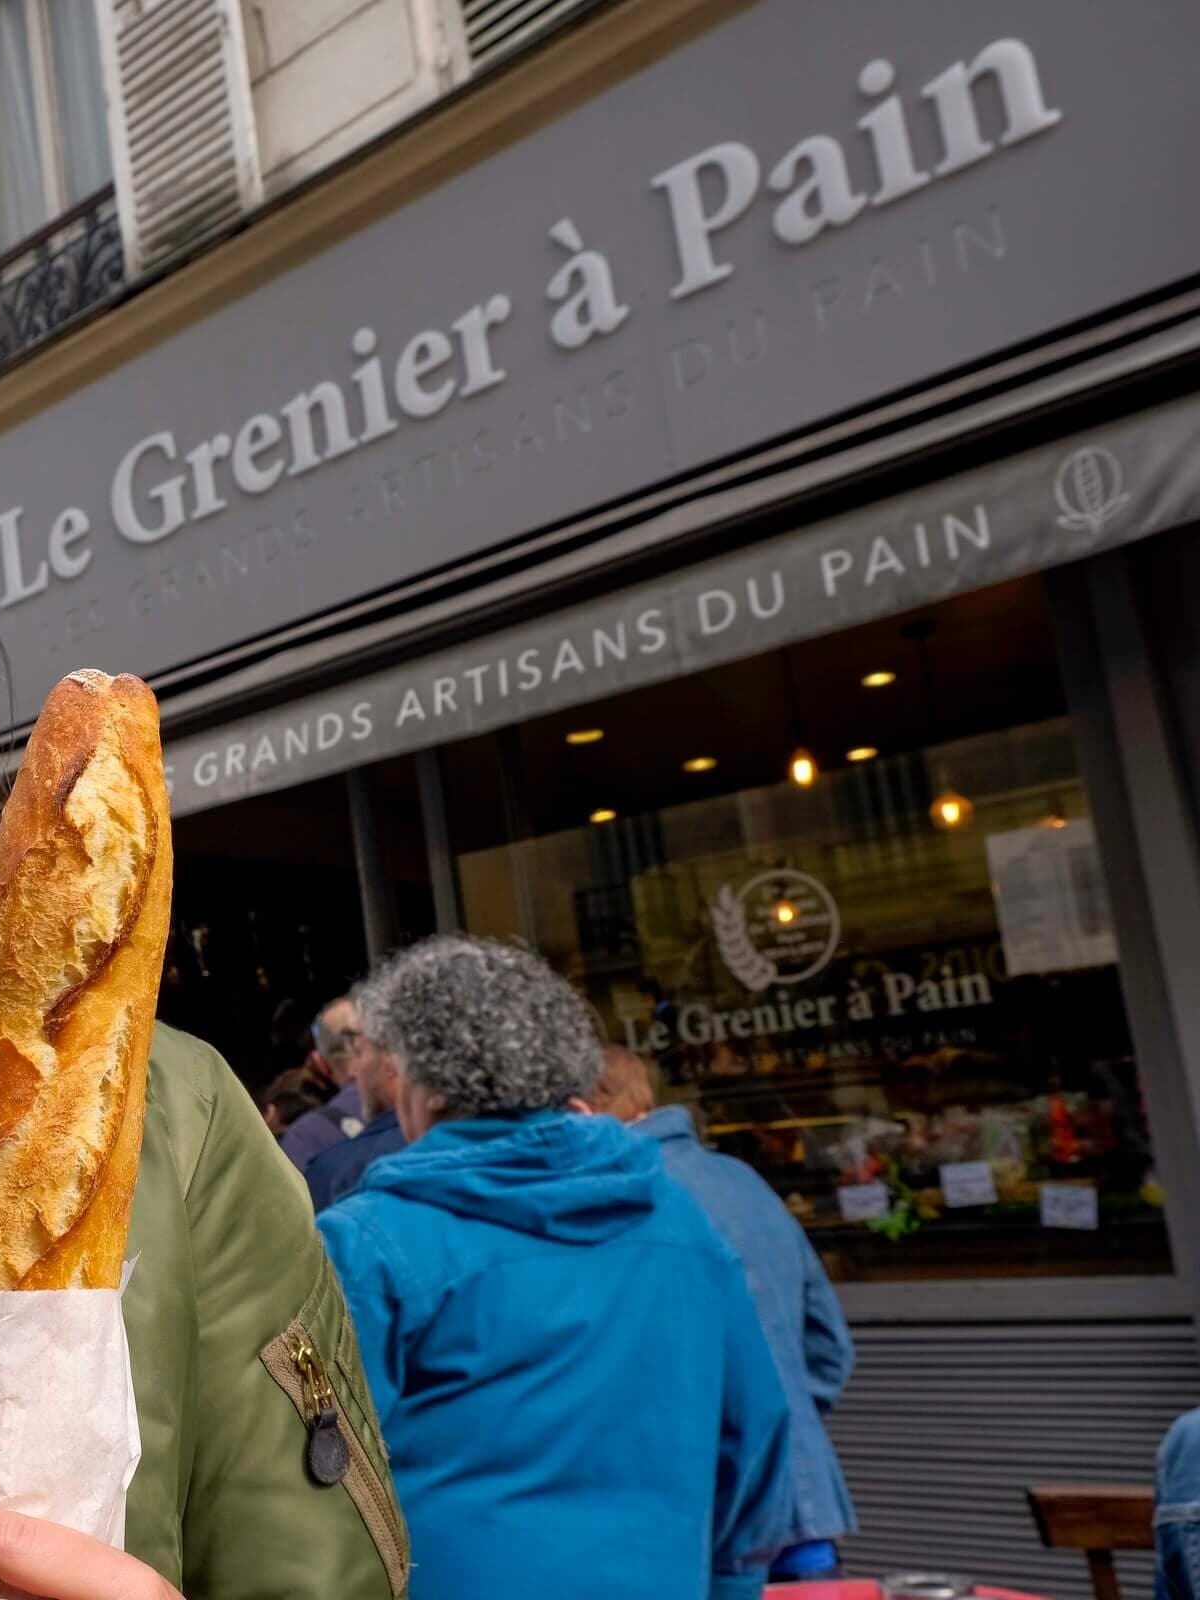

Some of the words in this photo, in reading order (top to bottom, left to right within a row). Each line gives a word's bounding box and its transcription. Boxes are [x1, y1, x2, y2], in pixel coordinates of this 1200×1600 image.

[110, 294, 511, 545] Grenier
[546, 217, 629, 349] à
[650, 37, 1063, 299] Pain
[342, 370, 632, 522] ARTISANS
[670, 307, 767, 392] DU
[812, 203, 1006, 330] PAIN
[193, 702, 373, 787] GRANDS
[395, 609, 668, 728] ARTISANS
[697, 569, 786, 636] DU
[820, 504, 991, 597] PAIN
[622, 1018, 671, 1054] Le
[677, 990, 838, 1048] Grenier
[846, 977, 874, 1023] à
[882, 963, 994, 1016] Pain
